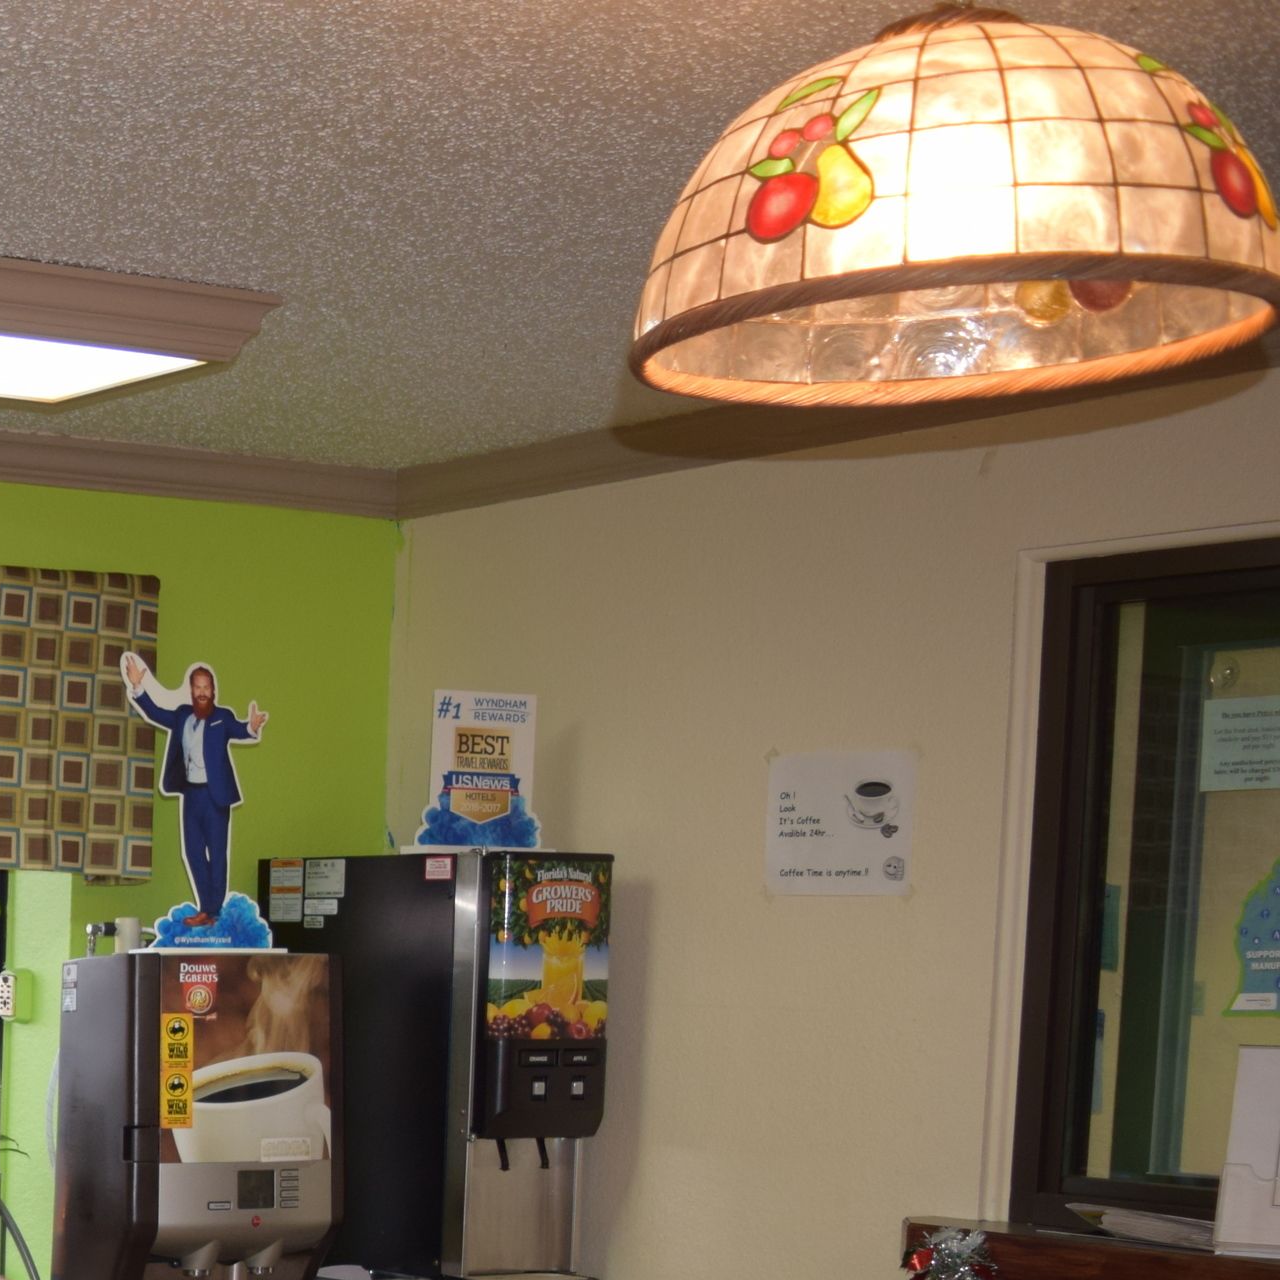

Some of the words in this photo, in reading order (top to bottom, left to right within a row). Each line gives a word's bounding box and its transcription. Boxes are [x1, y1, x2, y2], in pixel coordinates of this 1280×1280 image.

[438, 696, 461, 720] #1
[474, 698, 527, 709] WYNDHAM
[474, 711, 527, 724] REWARDS
[457, 733, 509, 756] BEST
[457, 756, 479, 769] TRAVEL
[479, 757, 509, 770] REWARDS
[465, 792, 497, 800] HOTELS
[780, 791, 791, 800] Oh
[779, 804, 796, 812] Look
[779, 817, 794, 825] It's
[796, 816, 821, 825] Coffee
[536, 866, 568, 882] Florida's
[568, 867, 592, 883] Natural
[779, 868, 803, 877] Coffee
[806, 868, 823, 877] Time
[834, 867, 862, 879] anytime
[546, 898, 583, 914] PRIDE
[180, 963, 217, 973] Douwe
[180, 973, 219, 984] EGBERTS
[168, 1046, 188, 1054] WILD
